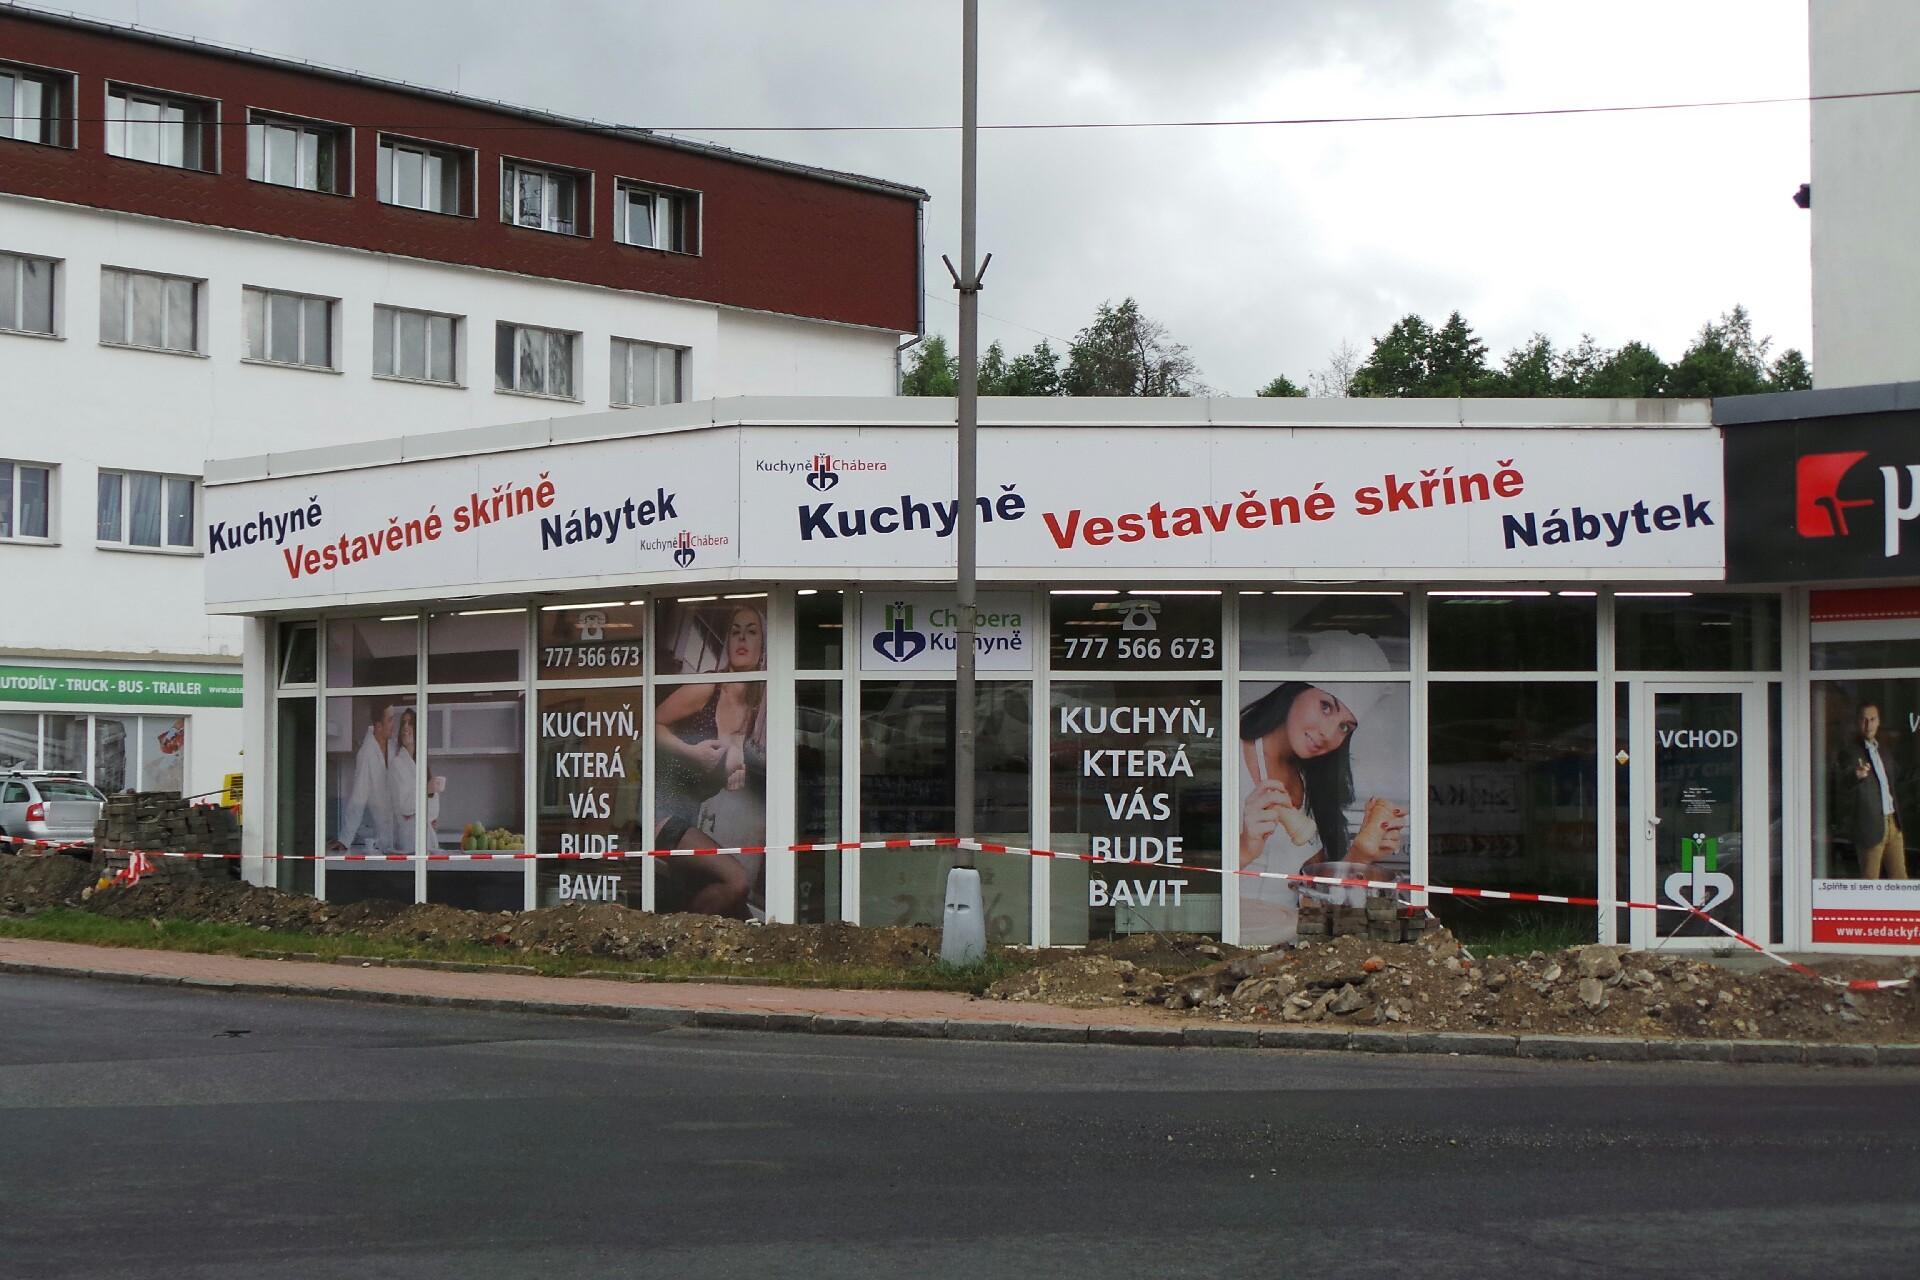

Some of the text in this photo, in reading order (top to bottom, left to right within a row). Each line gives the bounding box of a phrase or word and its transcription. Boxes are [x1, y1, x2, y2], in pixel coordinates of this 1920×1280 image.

[756, 459, 887, 474] Kuchyně Chábera
[1042, 458, 1525, 549] Vestavěné skříně
[208, 494, 322, 554] Kuchyně
[283, 471, 555, 579] Vestavěné skříně
[540, 488, 678, 550] Nábytek
[1502, 493, 1714, 549] Nábytek
[691, 534, 728, 546] Chábera
[929, 608, 1022, 628] Chbera
[545, 646, 639, 667] 777 566 673
[930, 630, 1022, 655] Kuyně
[1064, 638, 1214, 659] 777 566 673
[0, 675, 57, 691] UTODÍLY
[66, 679, 109, 692] TRUCK
[118, 680, 143, 693] BUS
[152, 681, 201, 695] TRAILER
[542, 703, 639, 740] KUCHYŇ,
[1060, 700, 1215, 738] KUCHYŇ,
[1658, 729, 1738, 749] VCHOD
[556, 746, 625, 778] KTERÁ
[1083, 744, 1194, 777] KTERÁ
[569, 787, 611, 819] VÁS
[1104, 786, 1171, 820] VÁS
[561, 833, 619, 860] BUDE
[1092, 836, 1183, 864] BUDE
[559, 875, 621, 900] BAVIT
[1089, 880, 1188, 907] BAVIT
